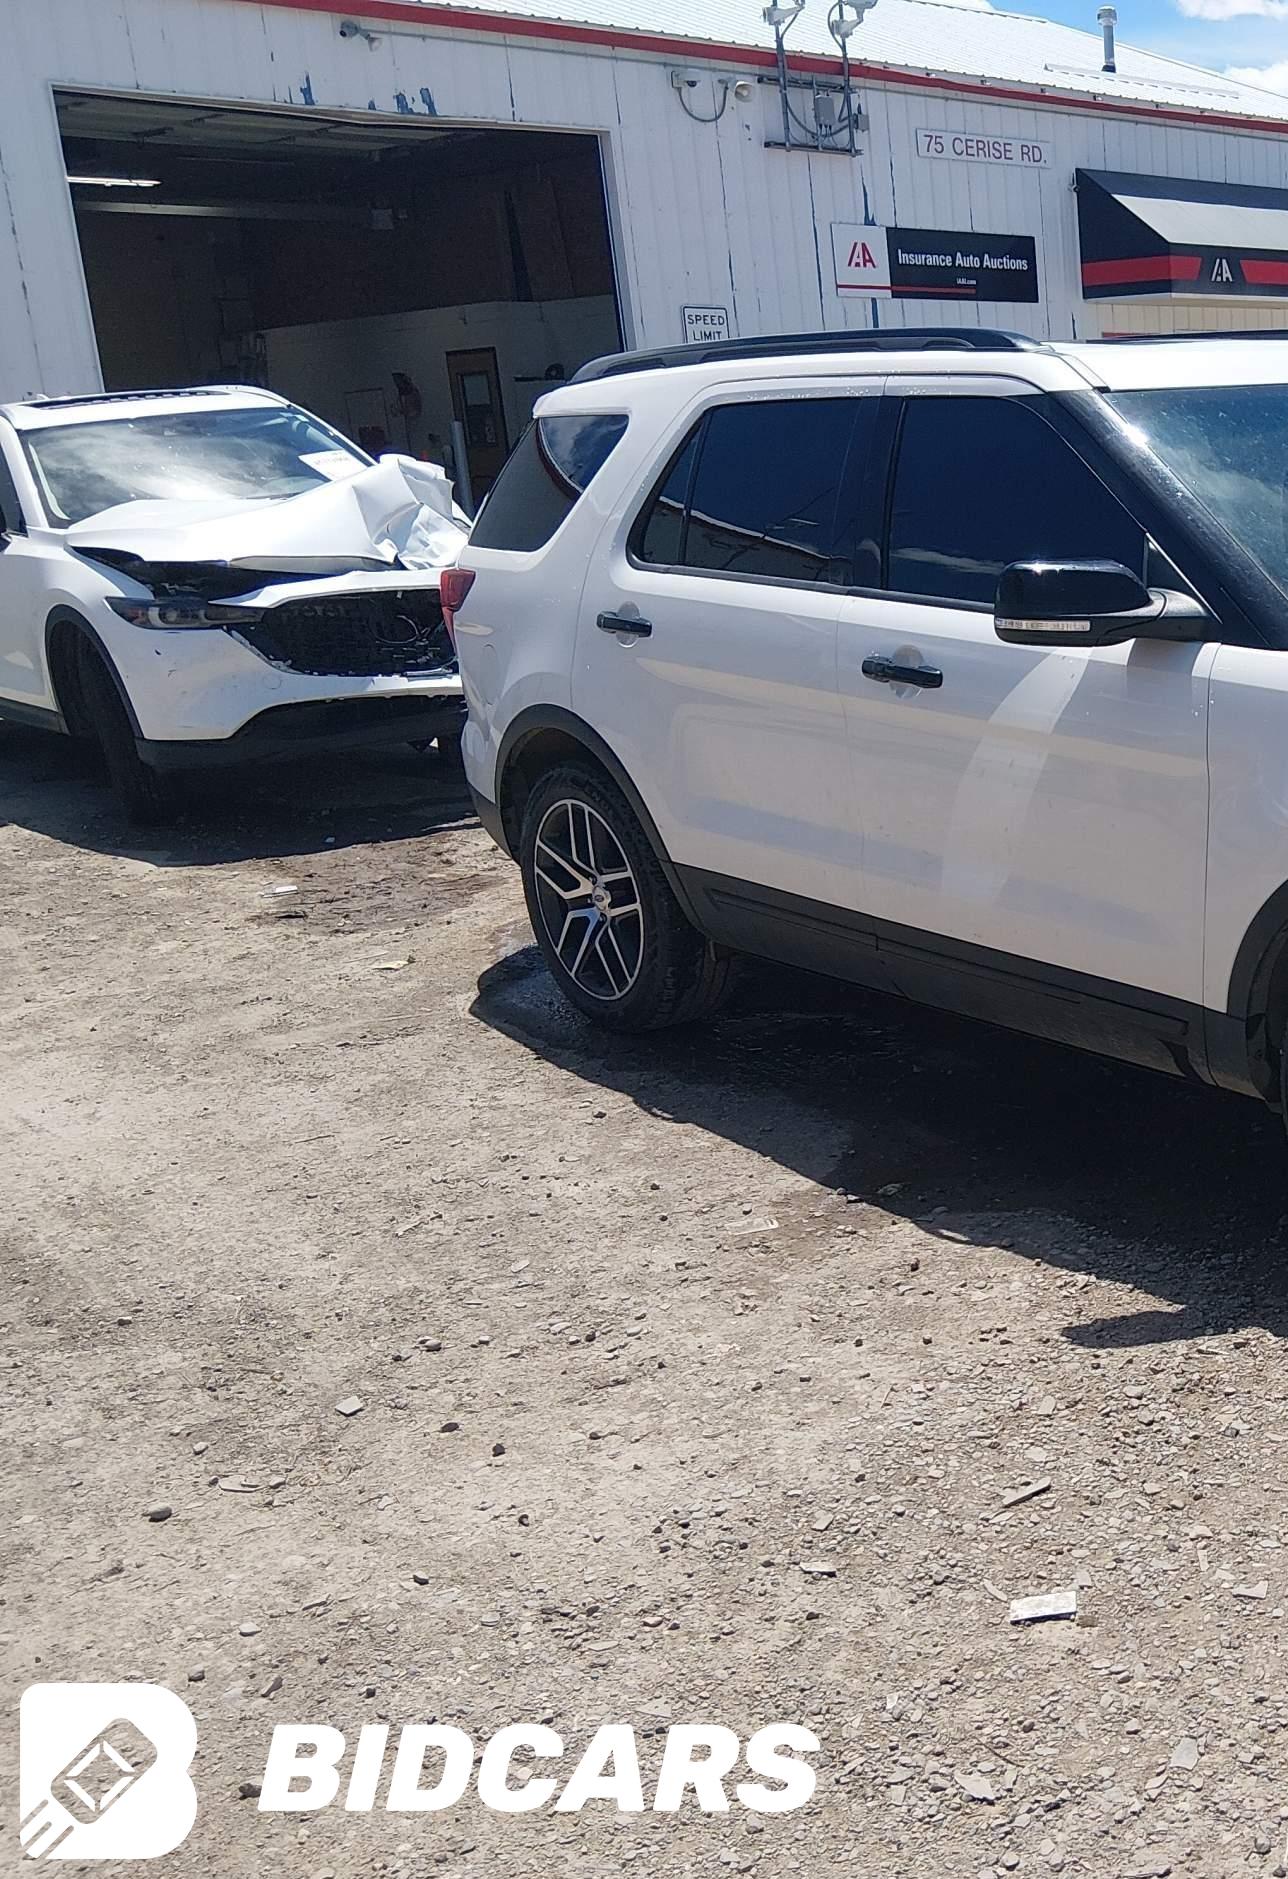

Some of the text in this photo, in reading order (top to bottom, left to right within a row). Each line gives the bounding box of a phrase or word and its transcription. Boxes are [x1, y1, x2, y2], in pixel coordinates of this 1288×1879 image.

[923, 134, 1047, 164] 75 CERISE RD.
[898, 249, 1029, 271] Insurance Auto Auctions
[687, 314, 725, 326] SPEED
[692, 330, 722, 341] LIMIT
